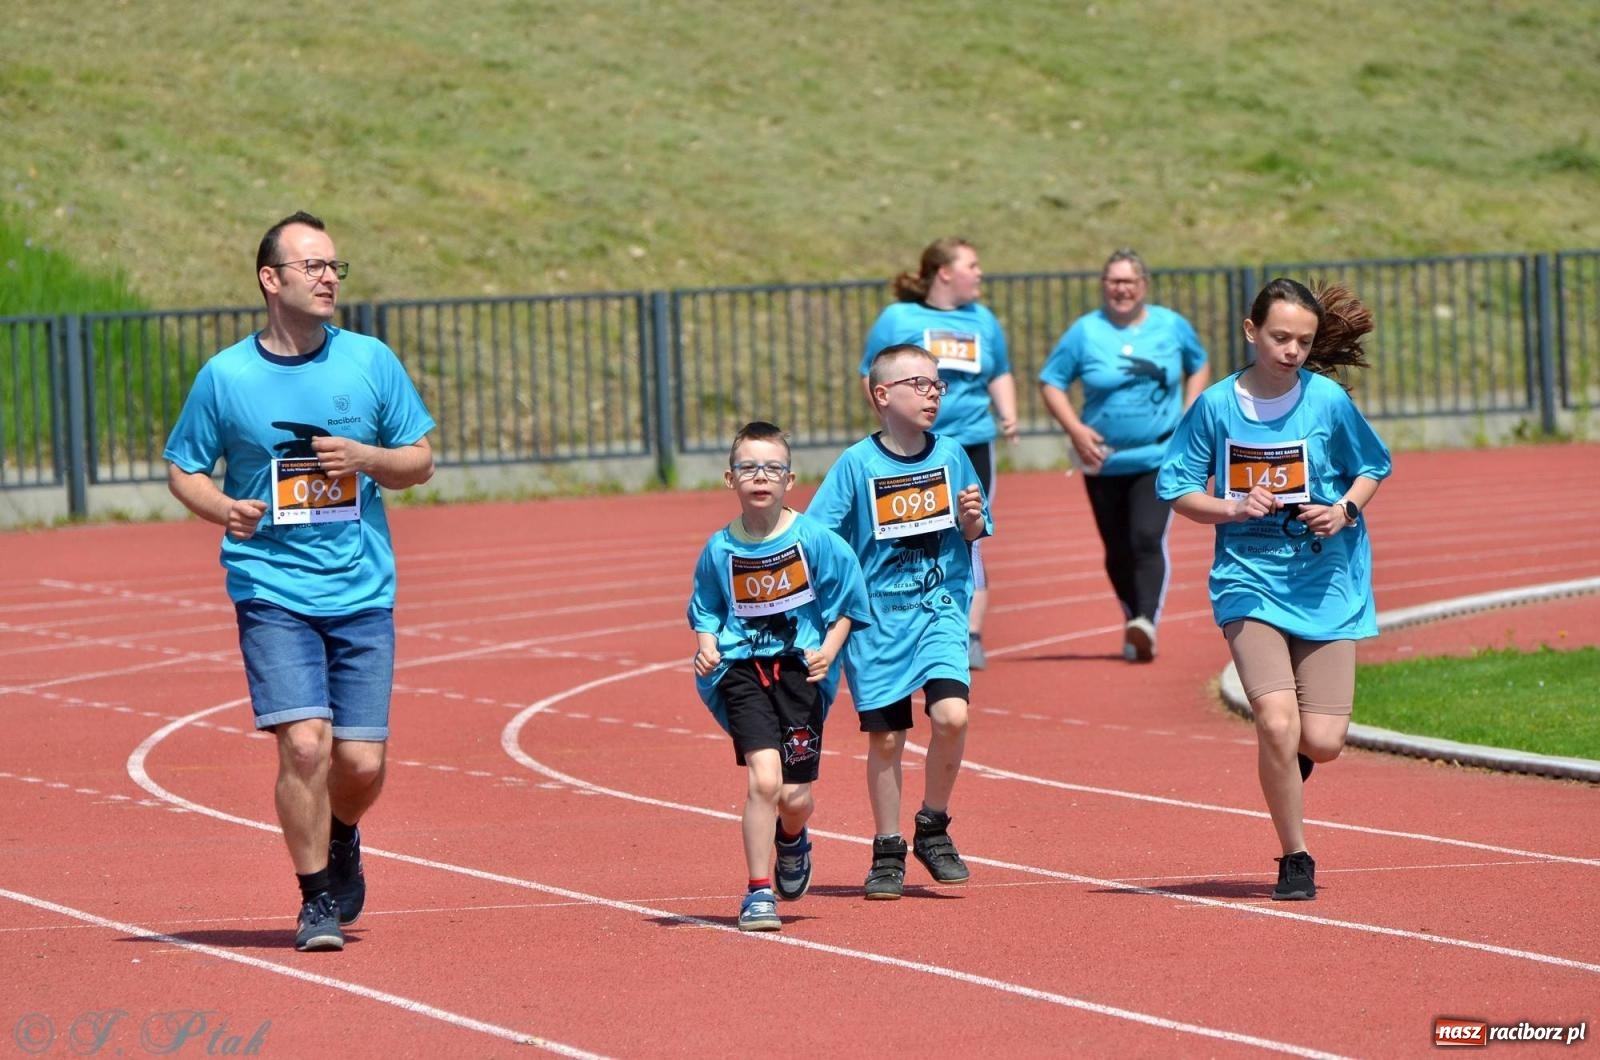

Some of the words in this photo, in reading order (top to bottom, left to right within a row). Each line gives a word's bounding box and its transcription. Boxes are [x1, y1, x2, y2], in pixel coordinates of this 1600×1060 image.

[1245, 466, 1288, 488] 145
[293, 478, 342, 503] 096
[892, 490, 936, 517] 098
[745, 569, 792, 597] 094
